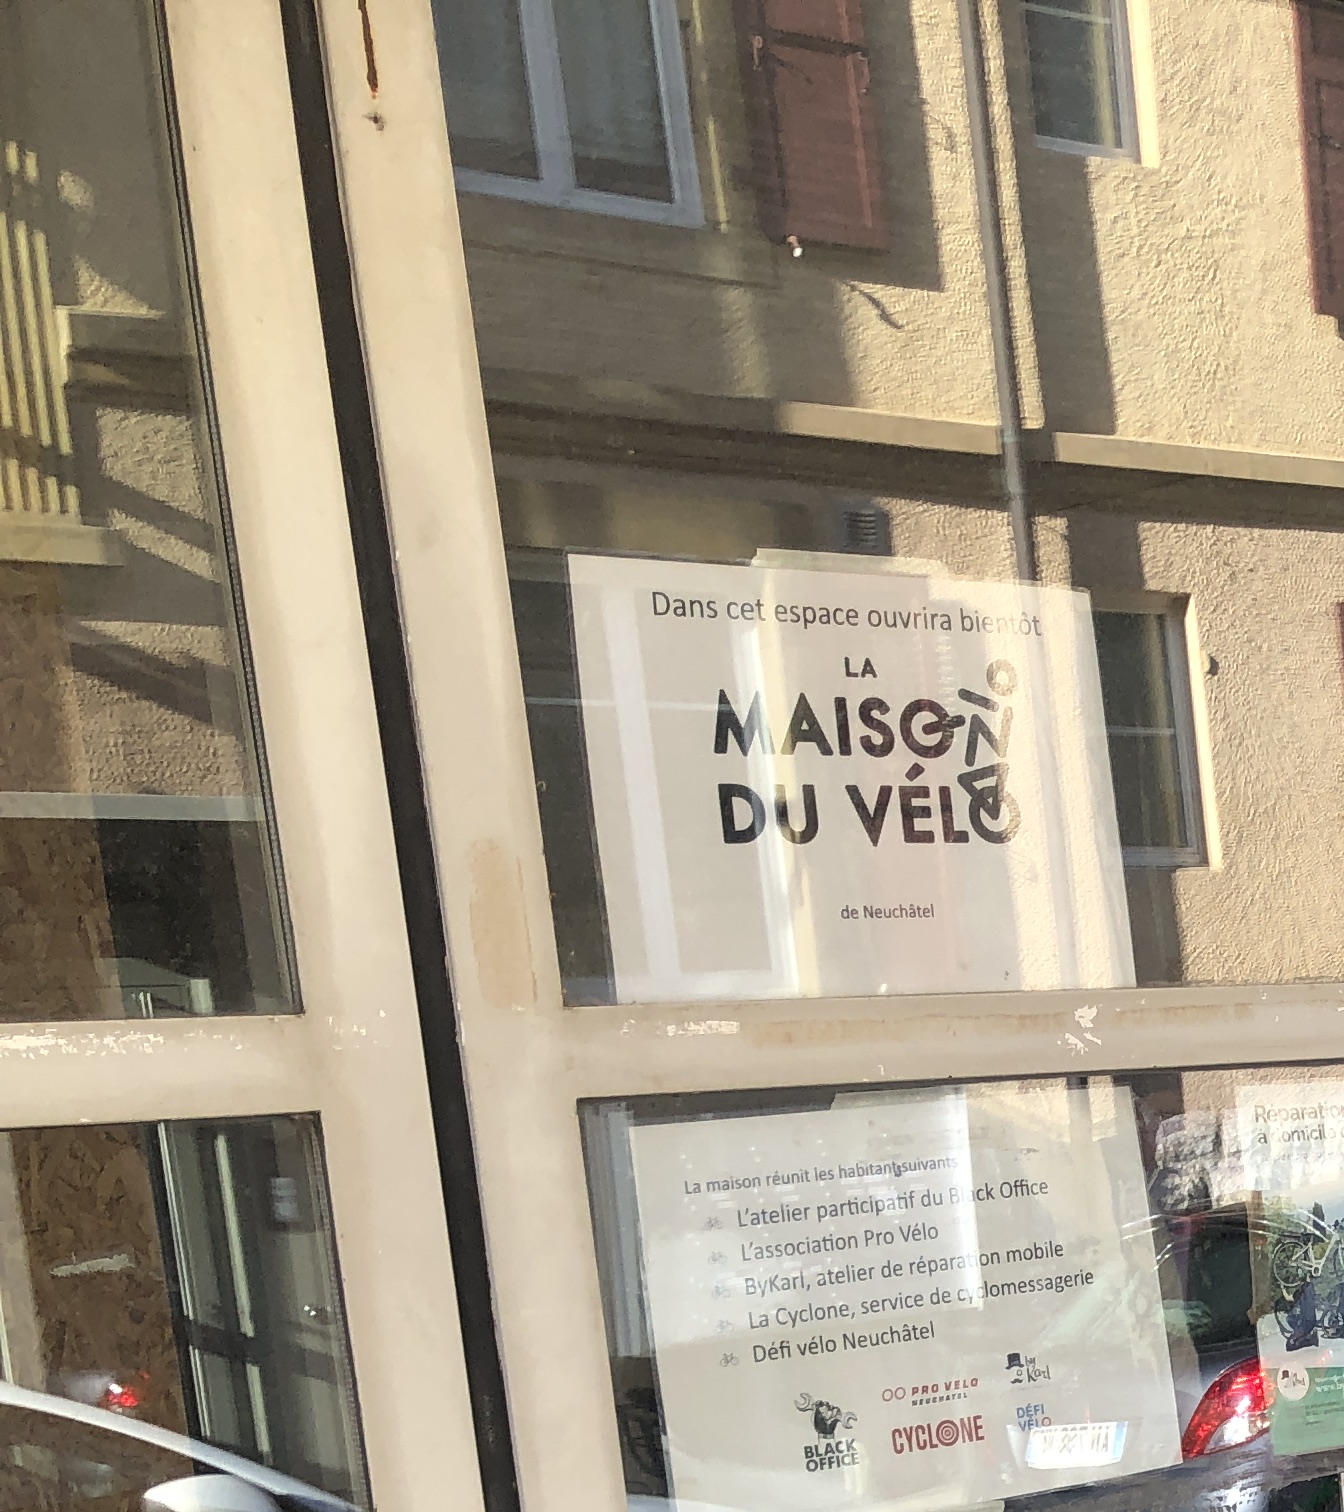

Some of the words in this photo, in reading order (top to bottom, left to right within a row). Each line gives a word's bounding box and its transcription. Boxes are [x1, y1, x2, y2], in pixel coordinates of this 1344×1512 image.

[651, 591, 719, 620] Dans
[726, 597, 767, 622] cet
[775, 604, 860, 631] espace
[867, 607, 953, 633] ouvrira
[961, 608, 1043, 637] bientôt
[844, 656, 878, 679] LA
[713, 688, 1013, 767] MAISON
[717, 783, 820, 845] DU
[845, 763, 1021, 848] VÉLO
[840, 904, 860, 920] de
[862, 903, 935, 921] Neuchâtel
[684, 1180, 702, 1195] La
[705, 1176, 762, 1193] maison
[765, 1168, 811, 1187] réunit
[813, 1166, 835, 1182] les
[901, 1156, 959, 1174] suivants
[816, 1189, 916, 1224] participatif
[920, 1188, 945, 1208] du
[948, 1182, 997, 1203] Black
[999, 1178, 1049, 1199] Office
[863, 1229, 895, 1248] Pro
[898, 1222, 939, 1243] Vélo
[744, 1270, 811, 1298] ByKarl,
[816, 1262, 876, 1288] atelier
[880, 1258, 905, 1280] de
[908, 1251, 1002, 1279] réparation
[1005, 1240, 1064, 1263] mobile
[748, 1311, 770, 1330] La
[775, 1302, 856, 1329] Cyclone,
[860, 1294, 925, 1316] service
[929, 1286, 953, 1306] de
[956, 1269, 1095, 1306] cyclomessagerie
[752, 1340, 792, 1363] Défi
[796, 1335, 837, 1356] vélo
[842, 1320, 935, 1351] Neuchâtel
[911, 1384, 940, 1397] PRO
[943, 1377, 979, 1391] VELO
[1027, 1365, 1052, 1383] Karl
[1016, 1402, 1045, 1419] DÉFI
[803, 1438, 857, 1459] BLACK
[891, 1414, 985, 1455] CYCLONE
[805, 1453, 860, 1473] OFFICE
